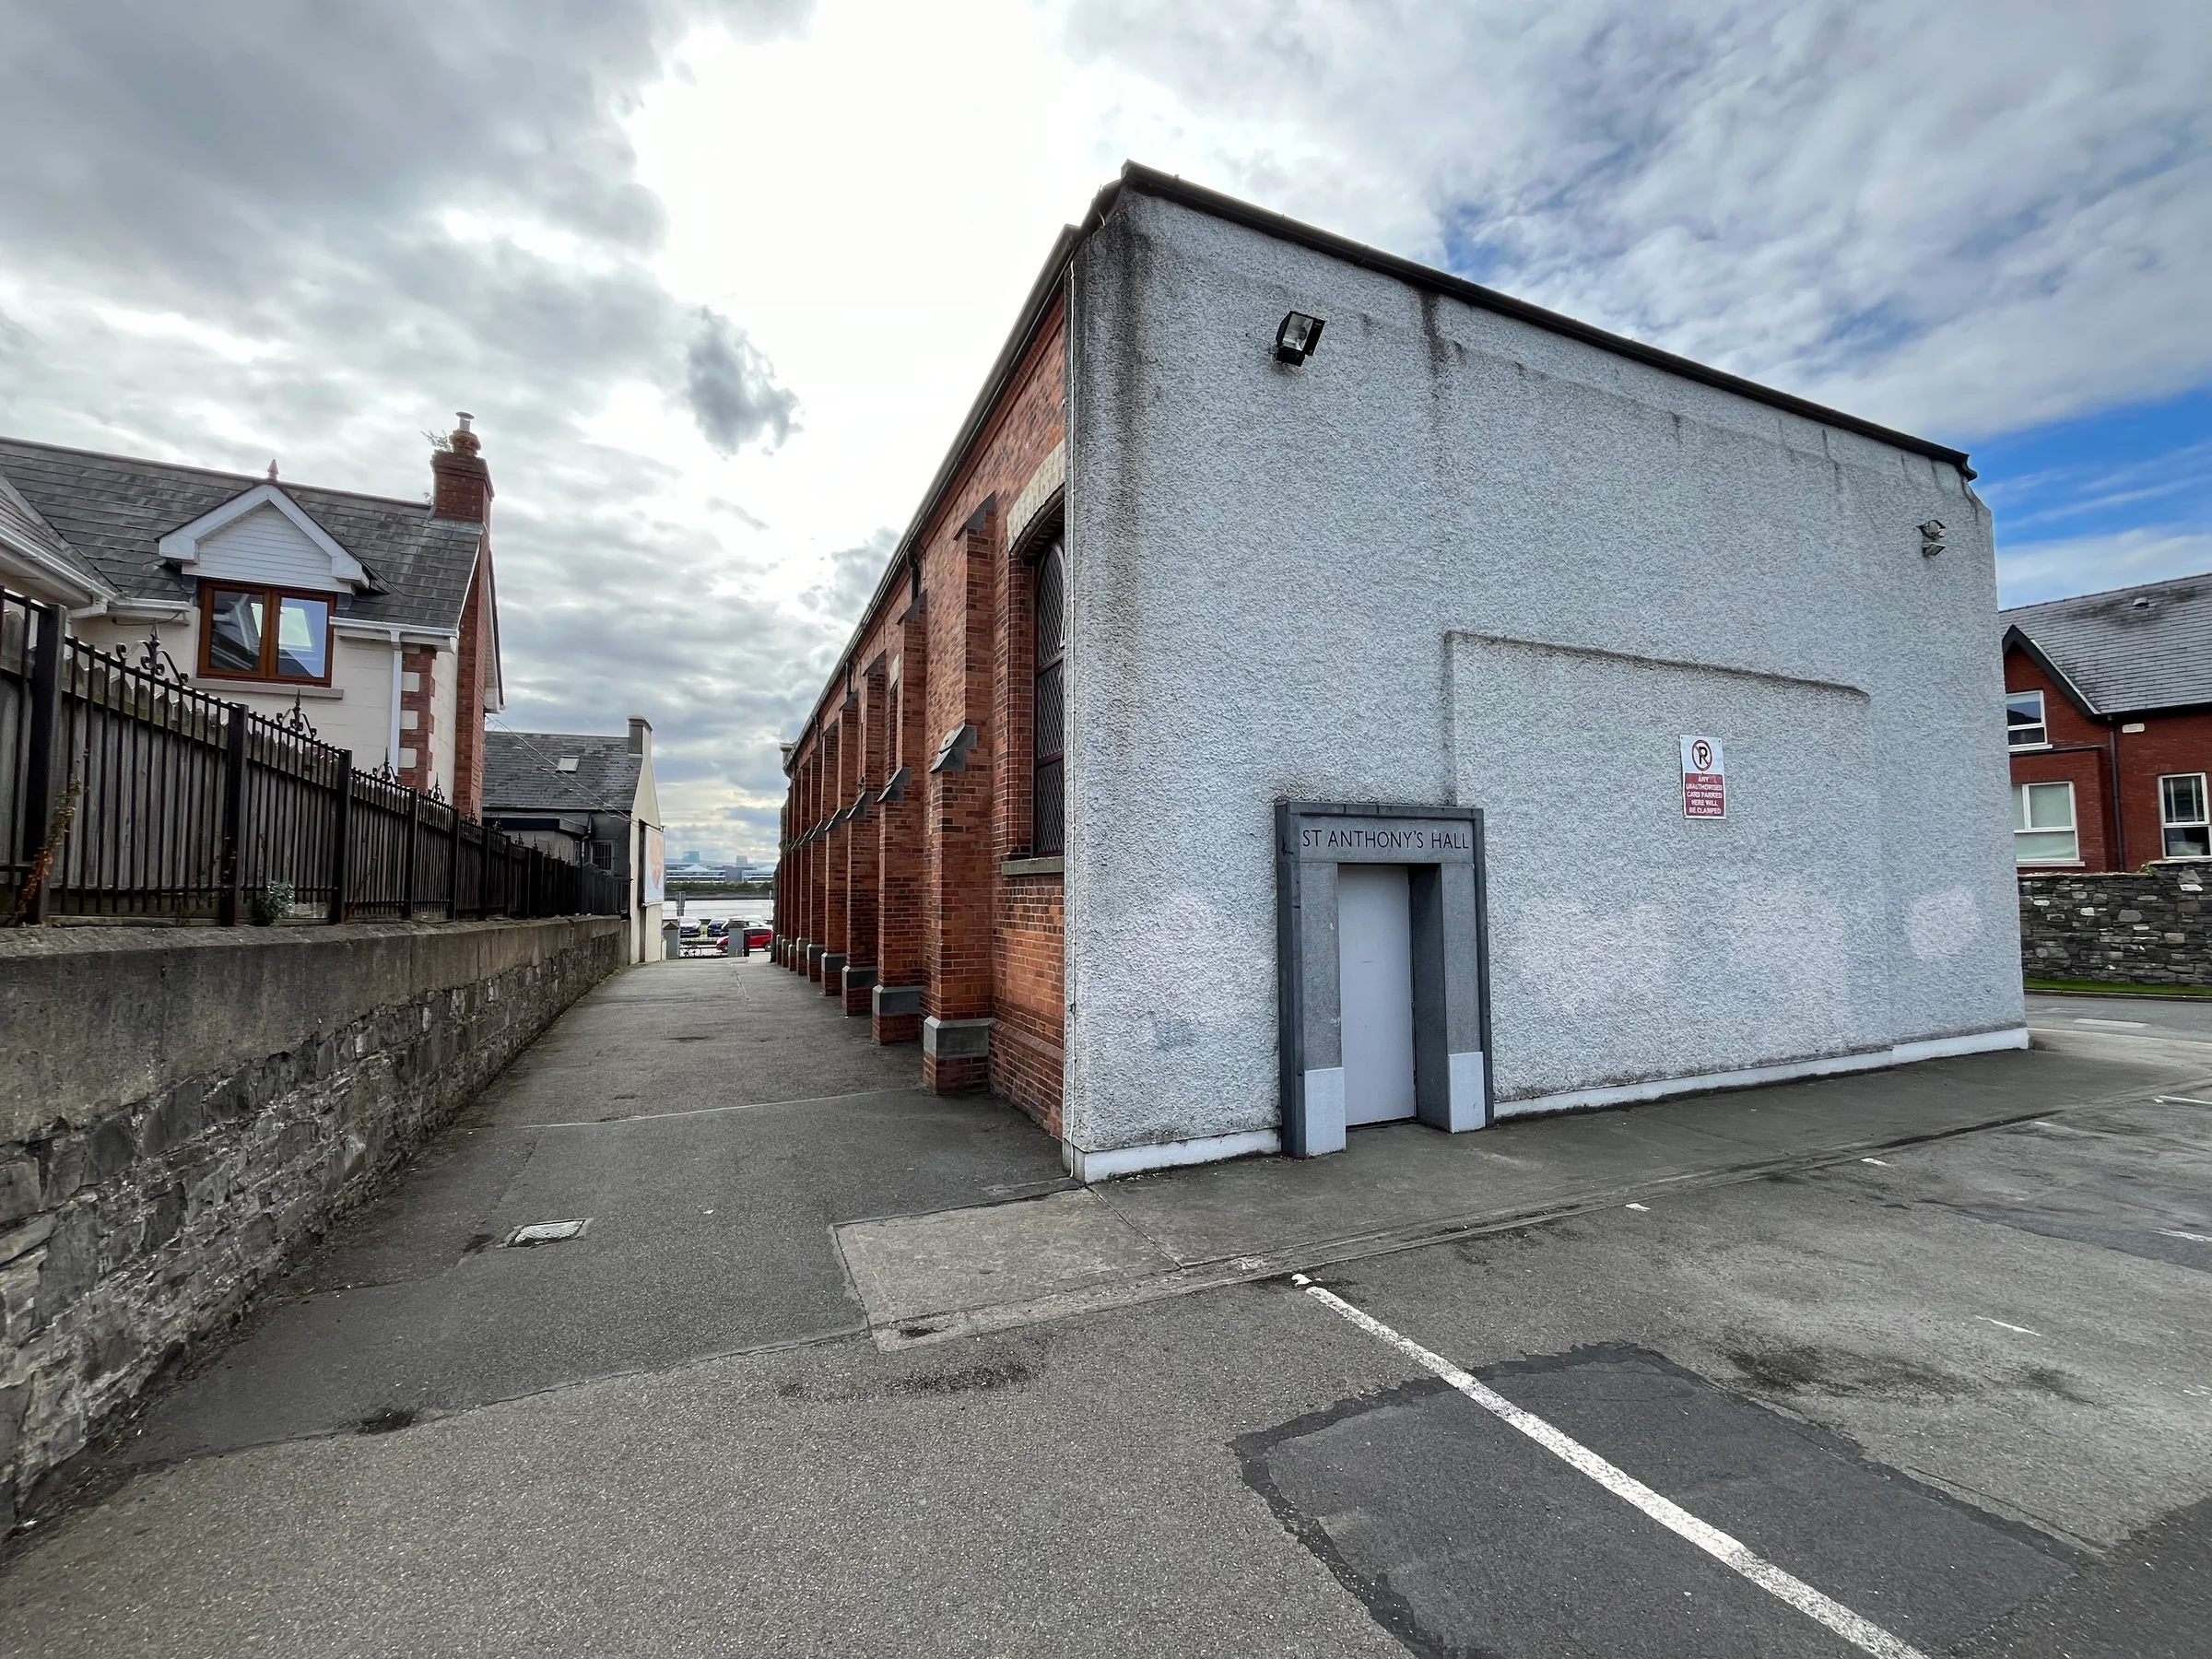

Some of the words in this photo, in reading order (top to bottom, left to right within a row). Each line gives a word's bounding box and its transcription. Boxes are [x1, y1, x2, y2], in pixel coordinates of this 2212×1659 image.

[1302, 830, 1323, 847] ST
[1327, 830, 1424, 849] ANTHONY'S
[1431, 832, 1469, 850] HALL
